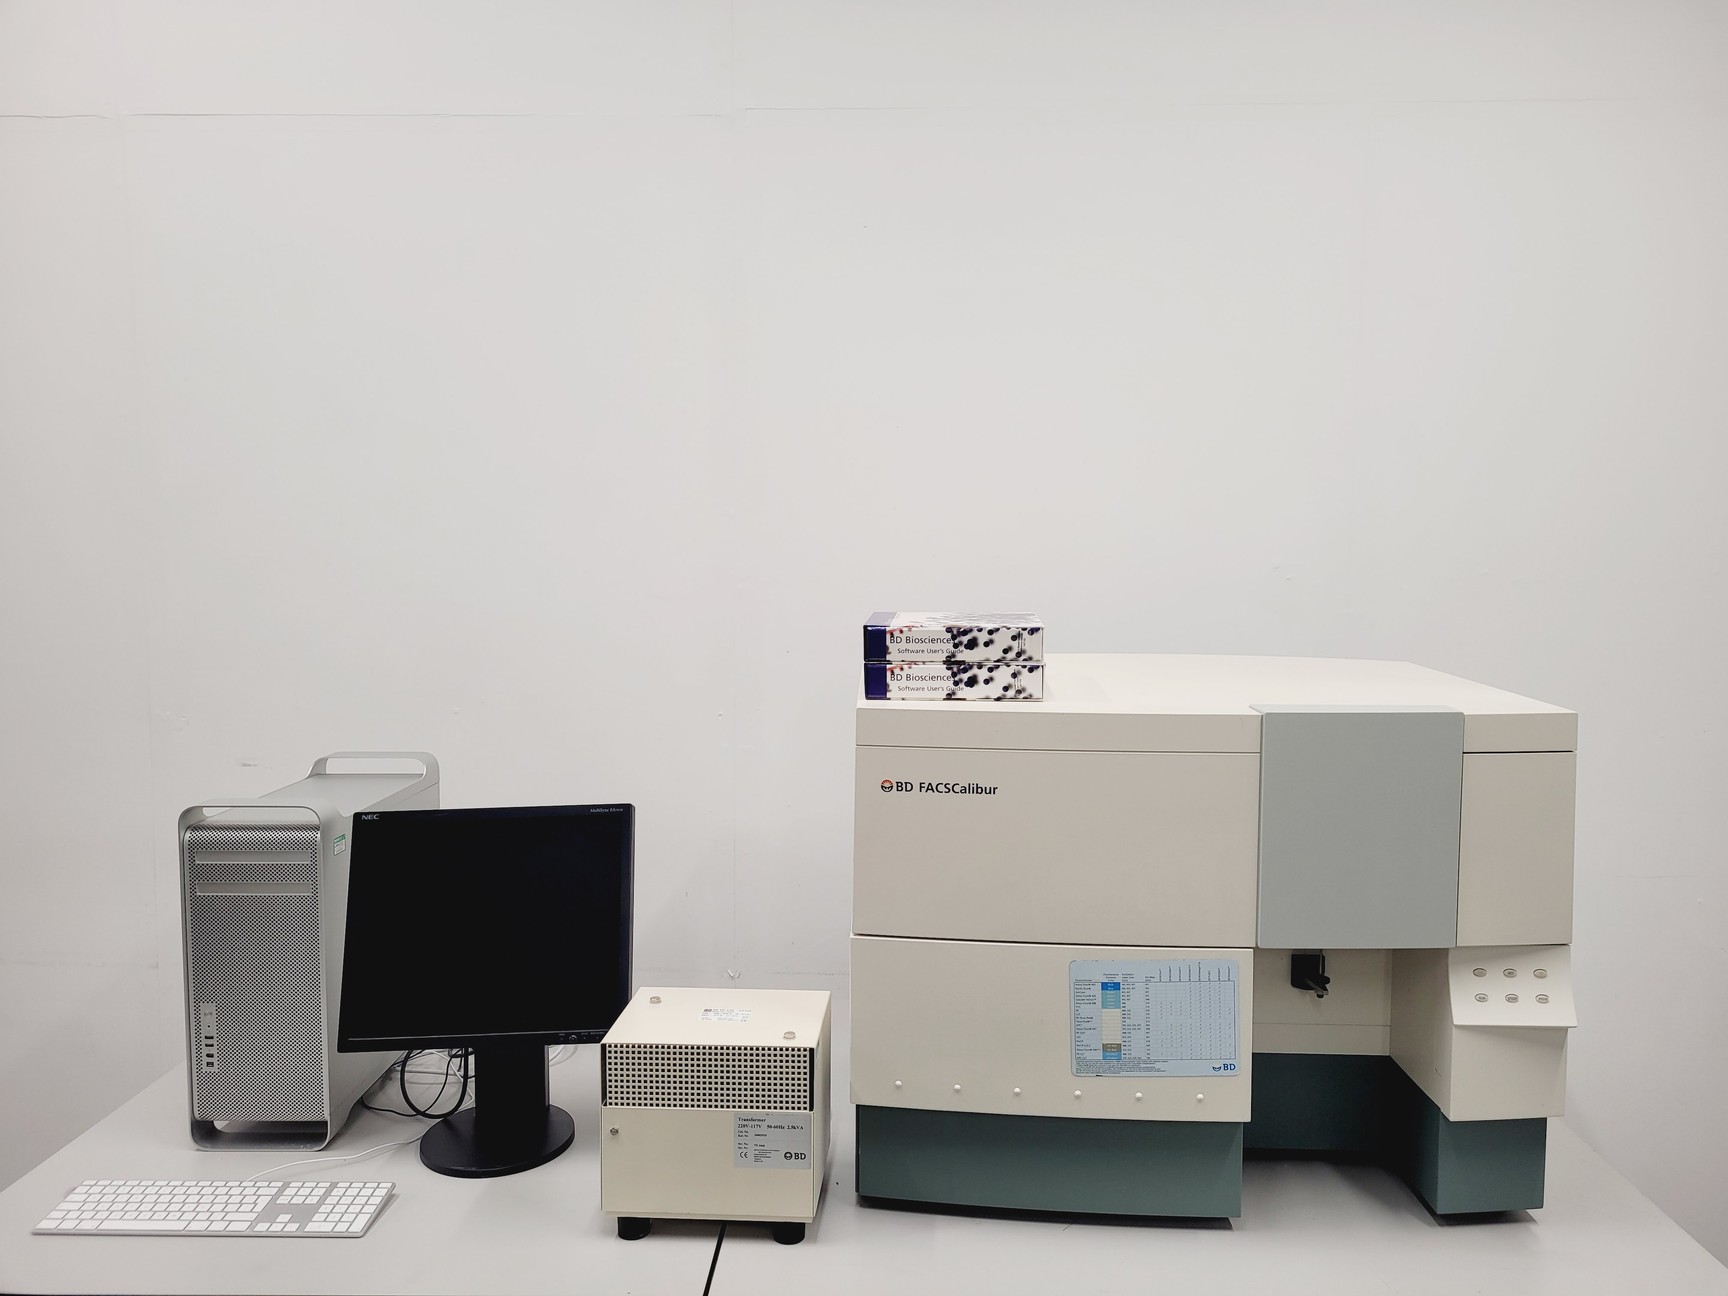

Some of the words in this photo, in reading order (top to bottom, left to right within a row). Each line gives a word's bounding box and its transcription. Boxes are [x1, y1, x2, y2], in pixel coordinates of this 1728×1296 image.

[889, 635, 903, 644] BD
[905, 635, 955, 645] Bioscience
[890, 673, 903, 682] BD
[905, 673, 955, 682] Bioscience
[895, 781, 914, 792] BD
[919, 782, 998, 795] FACSCalibur
[1223, 1063, 1236, 1071] BD
[794, 1152, 807, 1160] BD
